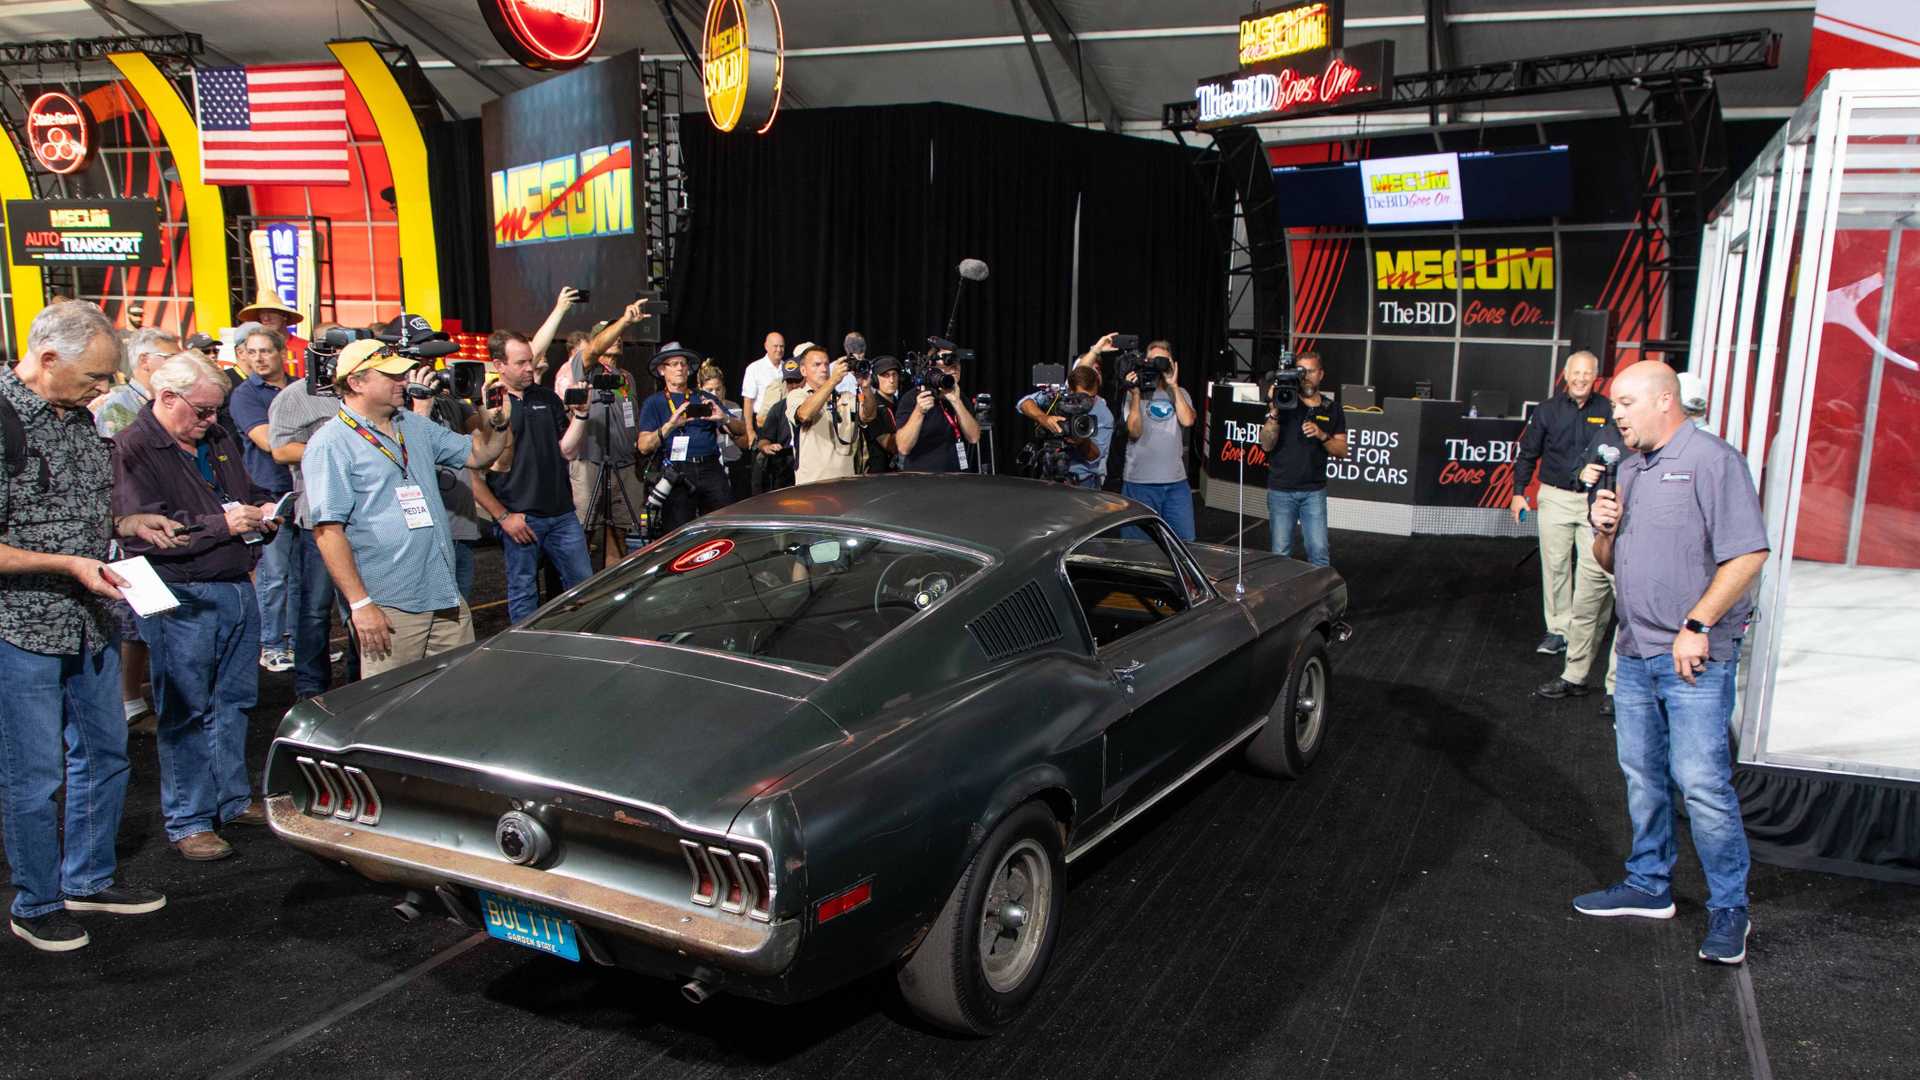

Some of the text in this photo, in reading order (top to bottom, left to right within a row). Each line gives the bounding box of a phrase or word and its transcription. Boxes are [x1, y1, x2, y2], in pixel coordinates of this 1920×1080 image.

[1240, 3, 1329, 65] MECUM
[706, 53, 740, 98] SOLD
[1232, 73, 1277, 114] BID
[1273, 68, 1317, 111] Goes
[1371, 170, 1450, 194] MECUM
[491, 140, 635, 249] MECUM
[1367, 196, 1386, 209] The
[1386, 194, 1408, 208] BID
[1408, 193, 1432, 208] Goes
[50, 208, 112, 228] MECUM
[25, 231, 142, 253] AUTO TRANSPORT
[1376, 246, 1554, 290] MECUM
[1379, 302, 1415, 325] The
[1416, 302, 1456, 325] BID
[1463, 300, 1506, 327] Goes
[1224, 420, 1265, 444] The BI
[1361, 429, 1399, 448] BIDS
[1356, 447, 1391, 466] FOR
[1445, 438, 1487, 462] The
[1364, 466, 1408, 485] CARS
[1439, 461, 1486, 485] Goes
[506, 932, 558, 953] GARDEN STATE
